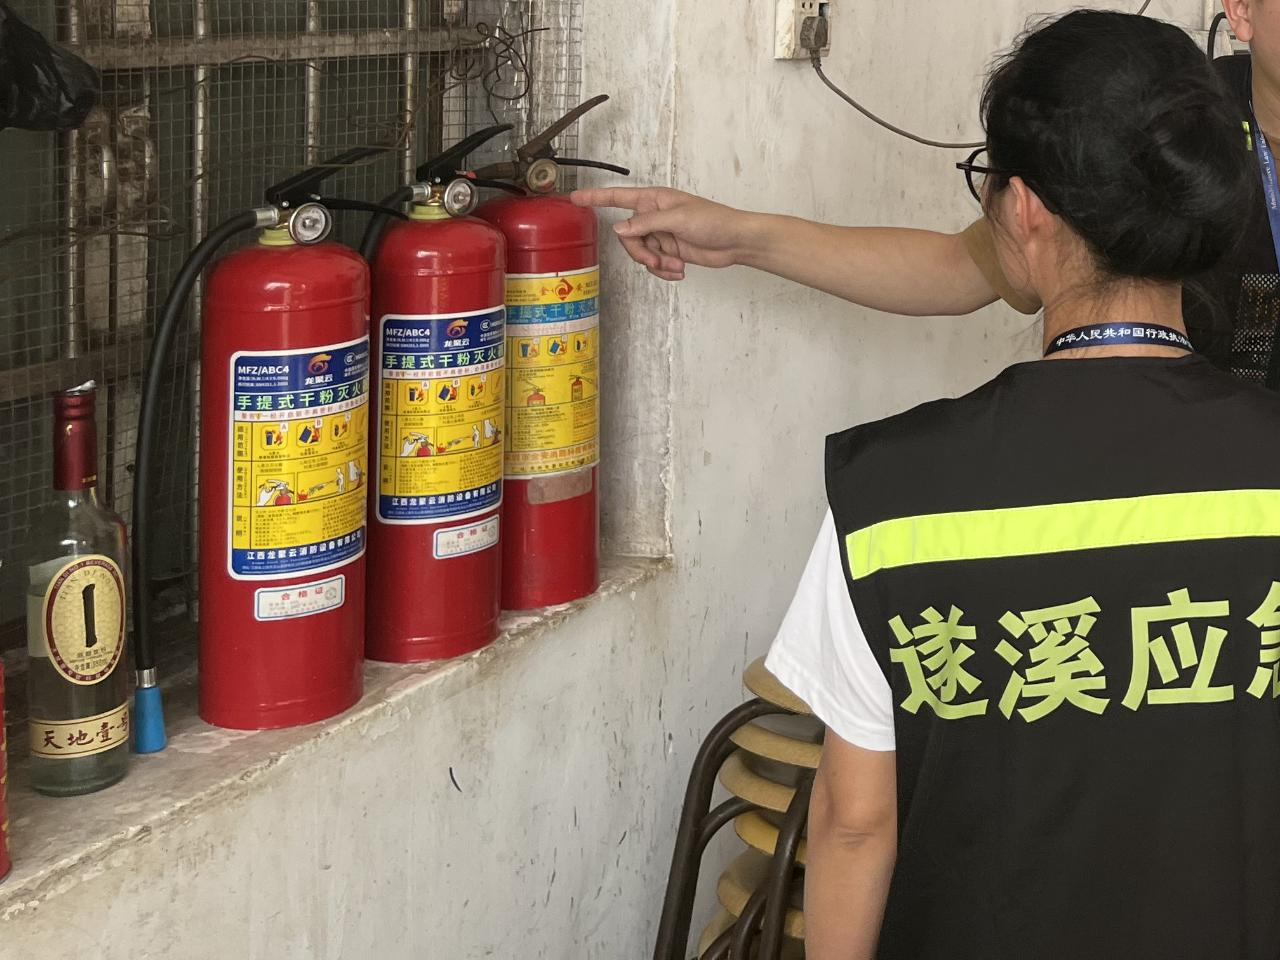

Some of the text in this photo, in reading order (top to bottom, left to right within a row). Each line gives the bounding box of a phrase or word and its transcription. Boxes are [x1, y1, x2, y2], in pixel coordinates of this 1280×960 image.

[386, 328, 430, 337] MFZ/ABC4
[238, 365, 290, 375] MFZ/ABC4
[43, 712, 128, 749] 天地壹号
